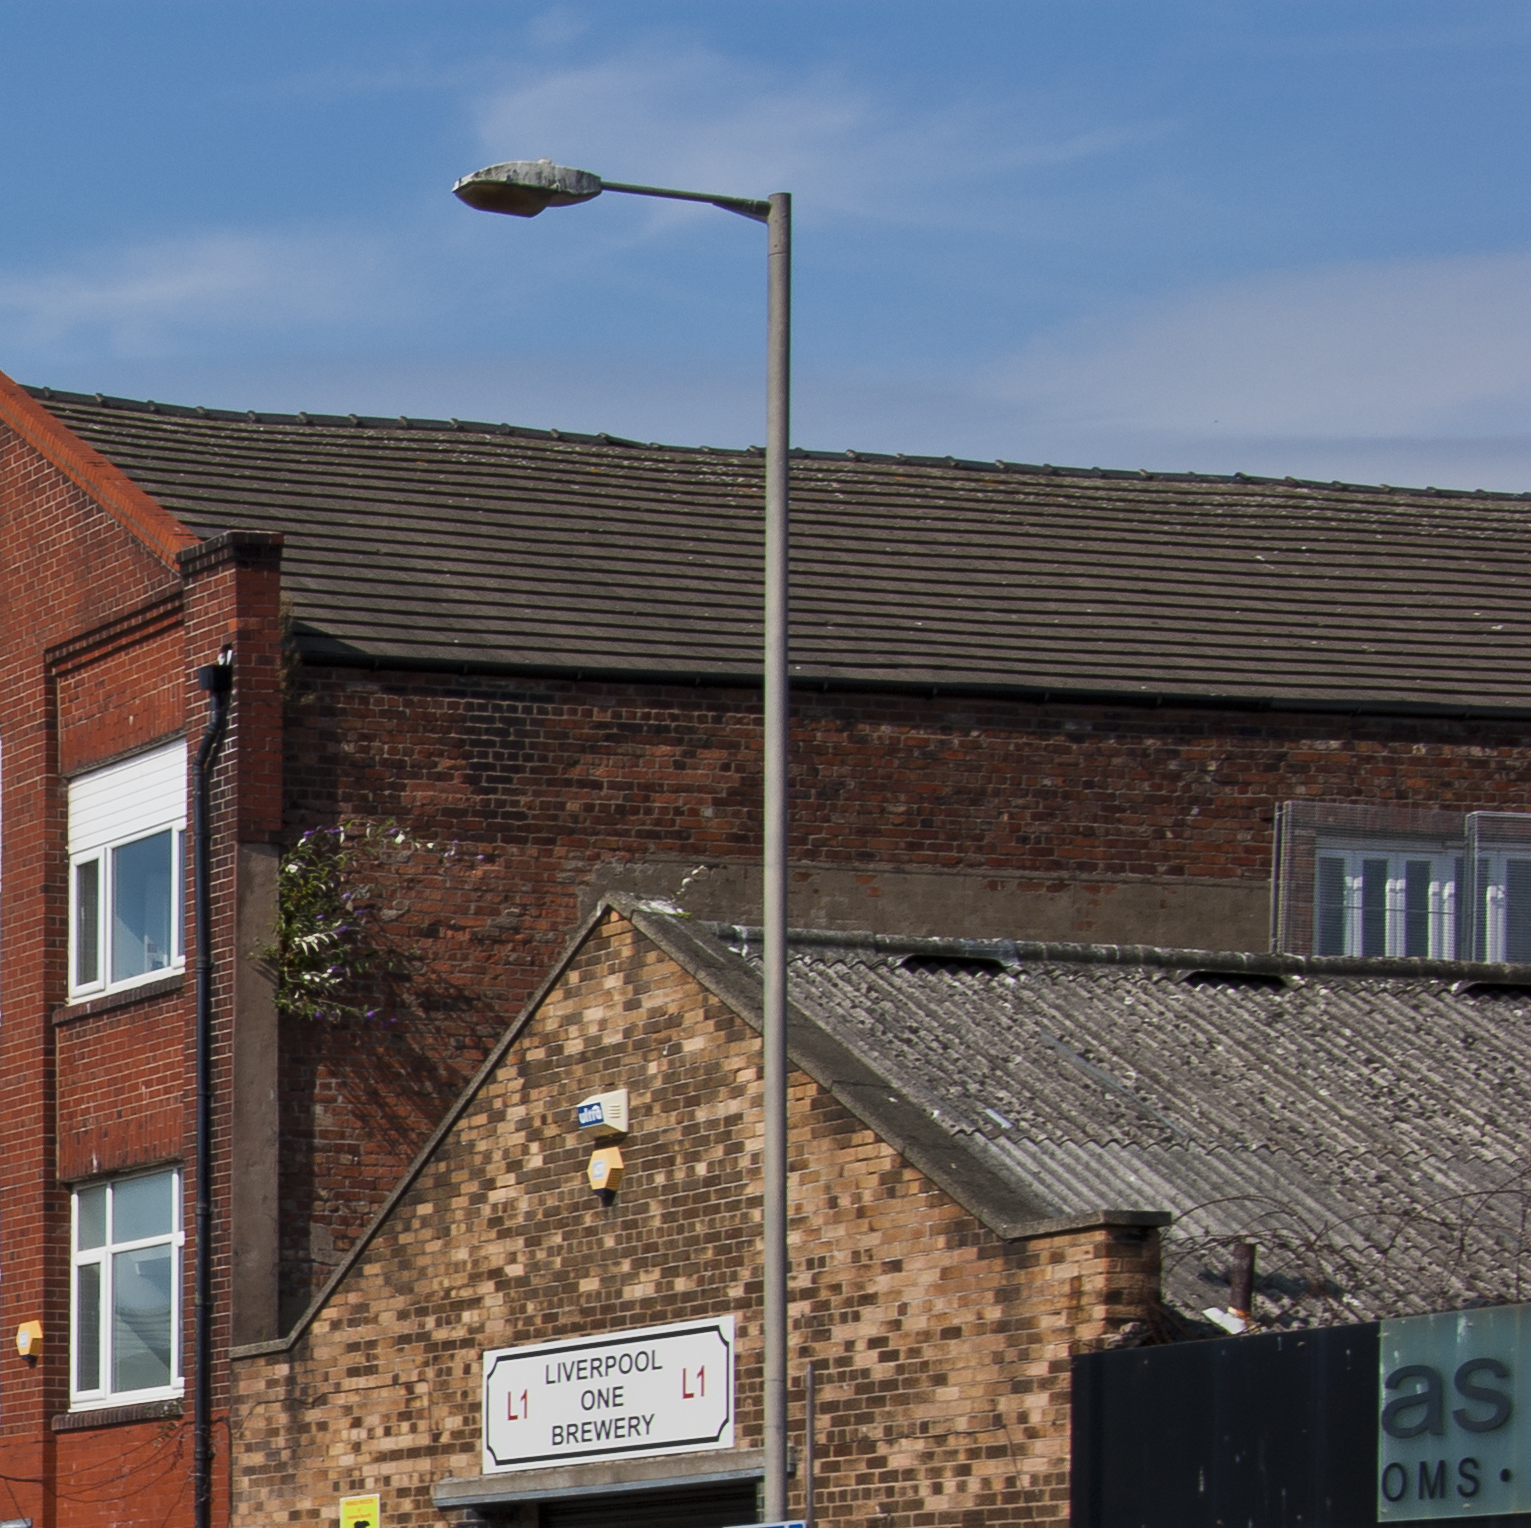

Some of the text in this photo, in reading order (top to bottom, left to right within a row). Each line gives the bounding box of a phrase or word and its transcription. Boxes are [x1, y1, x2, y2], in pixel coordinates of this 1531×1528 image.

[545, 1350, 663, 1385] LIVERPOOL
[681, 1365, 705, 1399] L1
[507, 1389, 528, 1421] L1
[581, 1386, 624, 1411] ONE
[552, 1414, 655, 1446] BREWERY
